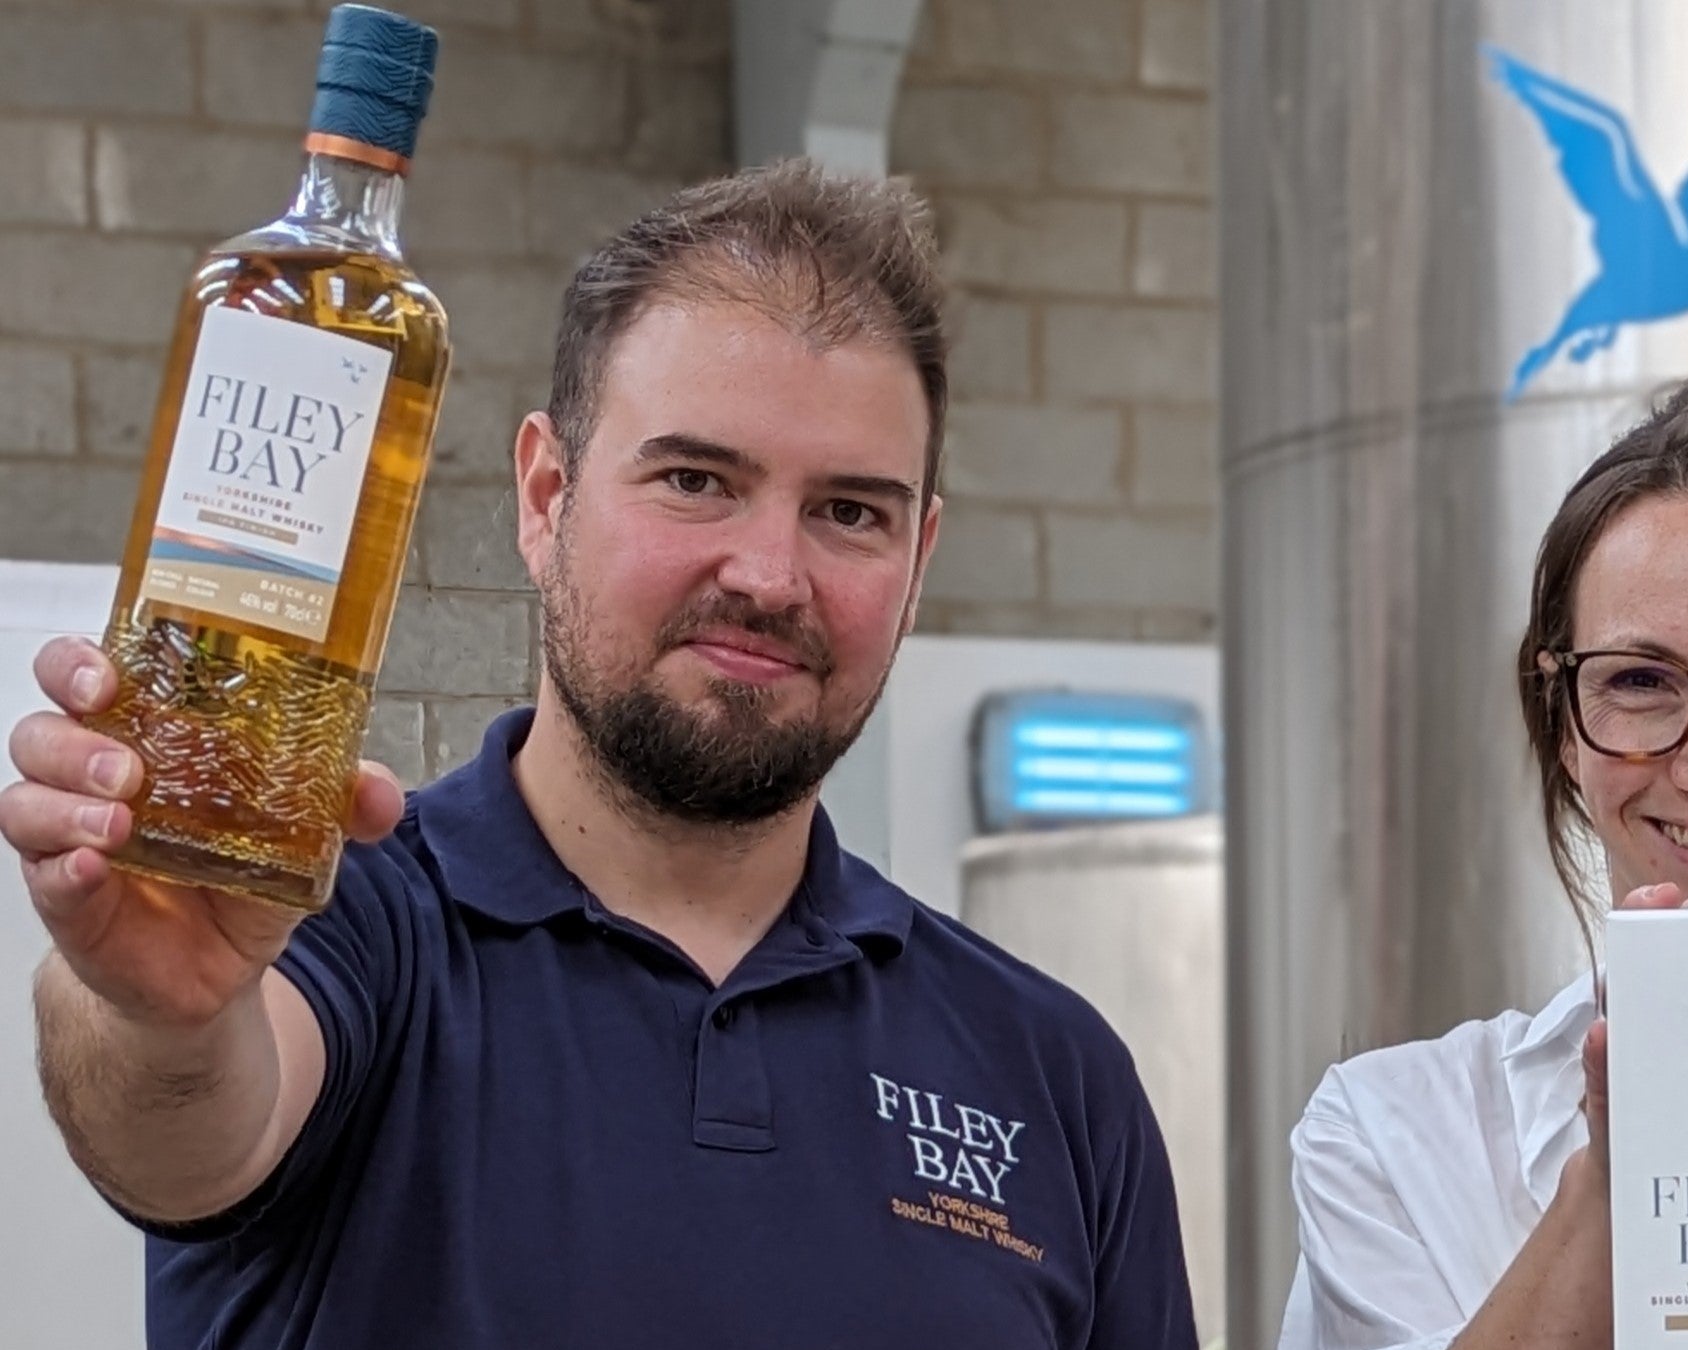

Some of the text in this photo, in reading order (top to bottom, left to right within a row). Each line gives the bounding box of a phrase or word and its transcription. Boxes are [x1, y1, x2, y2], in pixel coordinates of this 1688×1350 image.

[197, 374, 364, 453] FILEY
[209, 428, 327, 495] BAY
[183, 492, 324, 534] SINGLE MALT WHISKY
[216, 485, 292, 511] YORKSHIRE
[260, 580, 304, 599] BATCH
[870, 1072, 1026, 1164] FILEY
[907, 1134, 1011, 1205] BAY
[891, 1198, 1045, 1263] SINGLE MALT WHISKY
[928, 1191, 1010, 1230] YORKSHIRE
